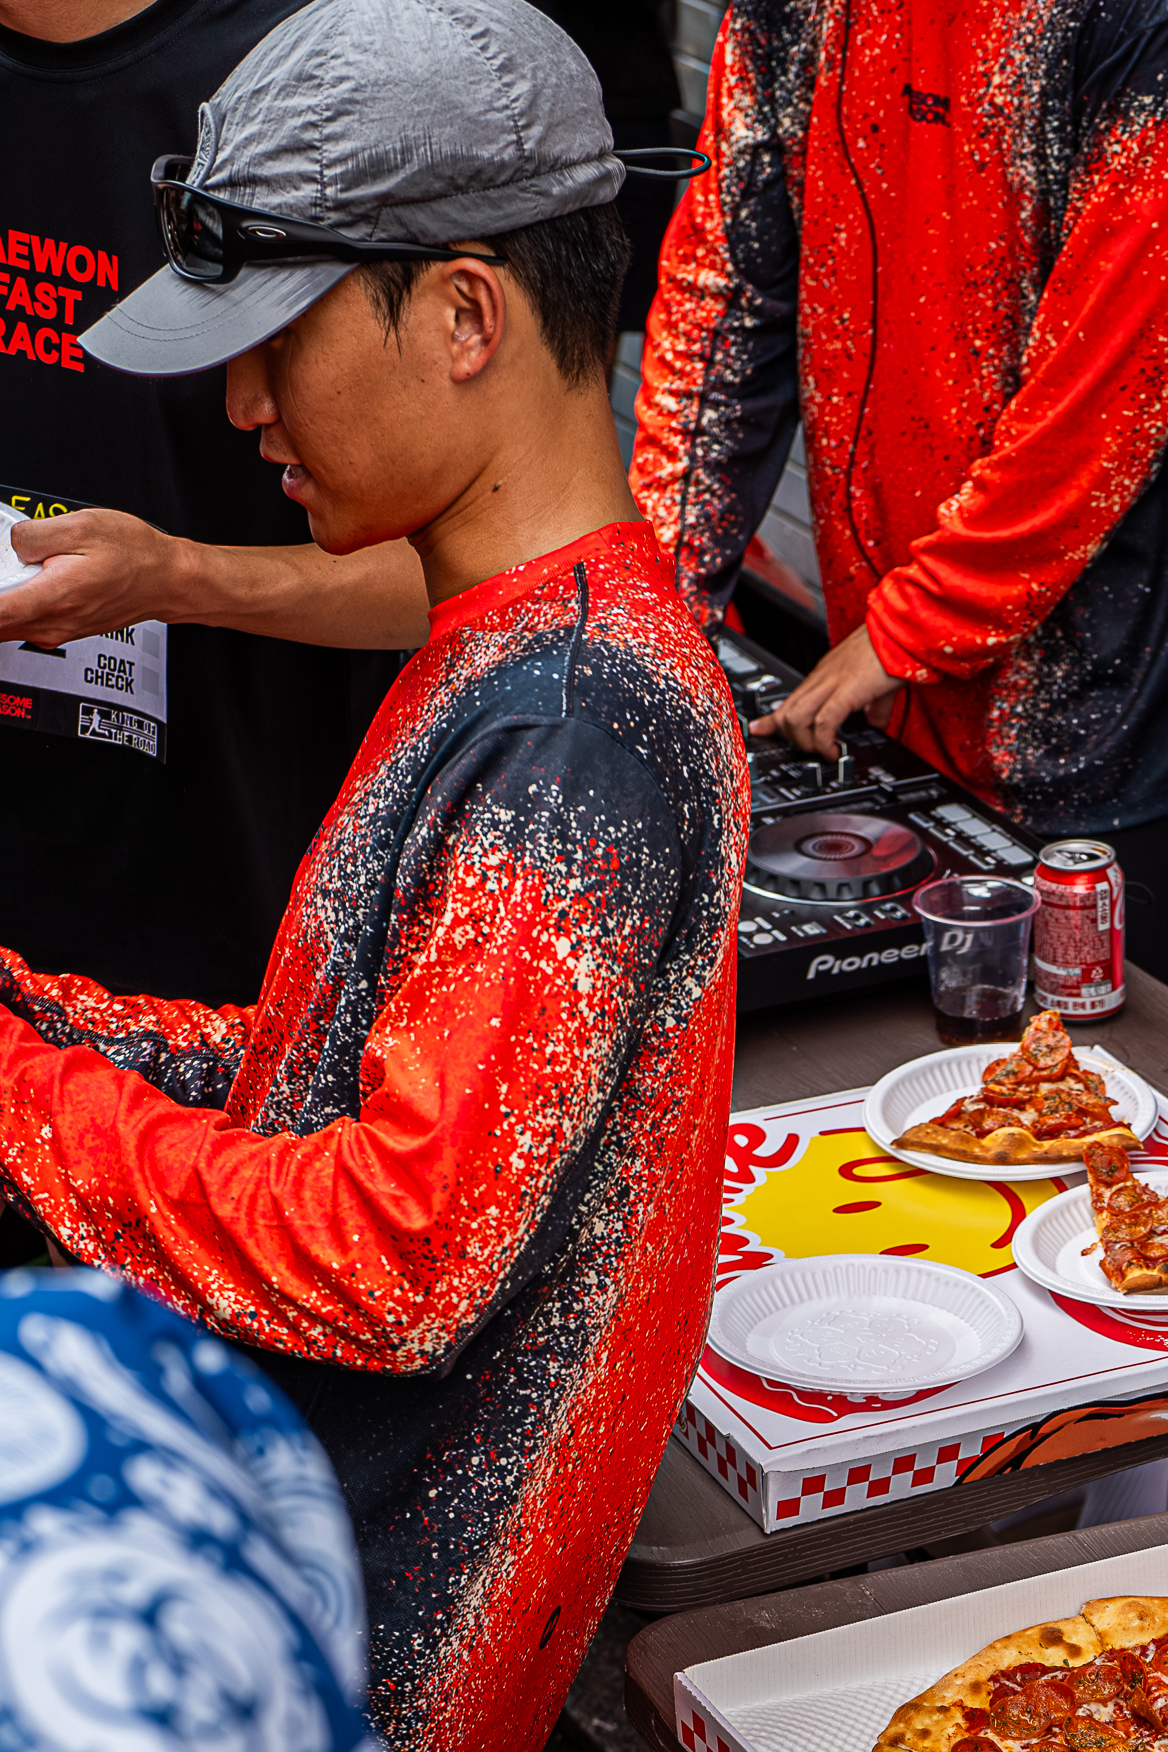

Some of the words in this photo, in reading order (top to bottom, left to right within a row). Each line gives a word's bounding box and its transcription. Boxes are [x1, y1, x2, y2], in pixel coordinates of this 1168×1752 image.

[97, 653, 135, 678] COAT
[84, 667, 134, 695] CHECK
[111, 710, 138, 729] KING
[111, 729, 129, 745] THE
[806, 939, 935, 980] Pioneer
